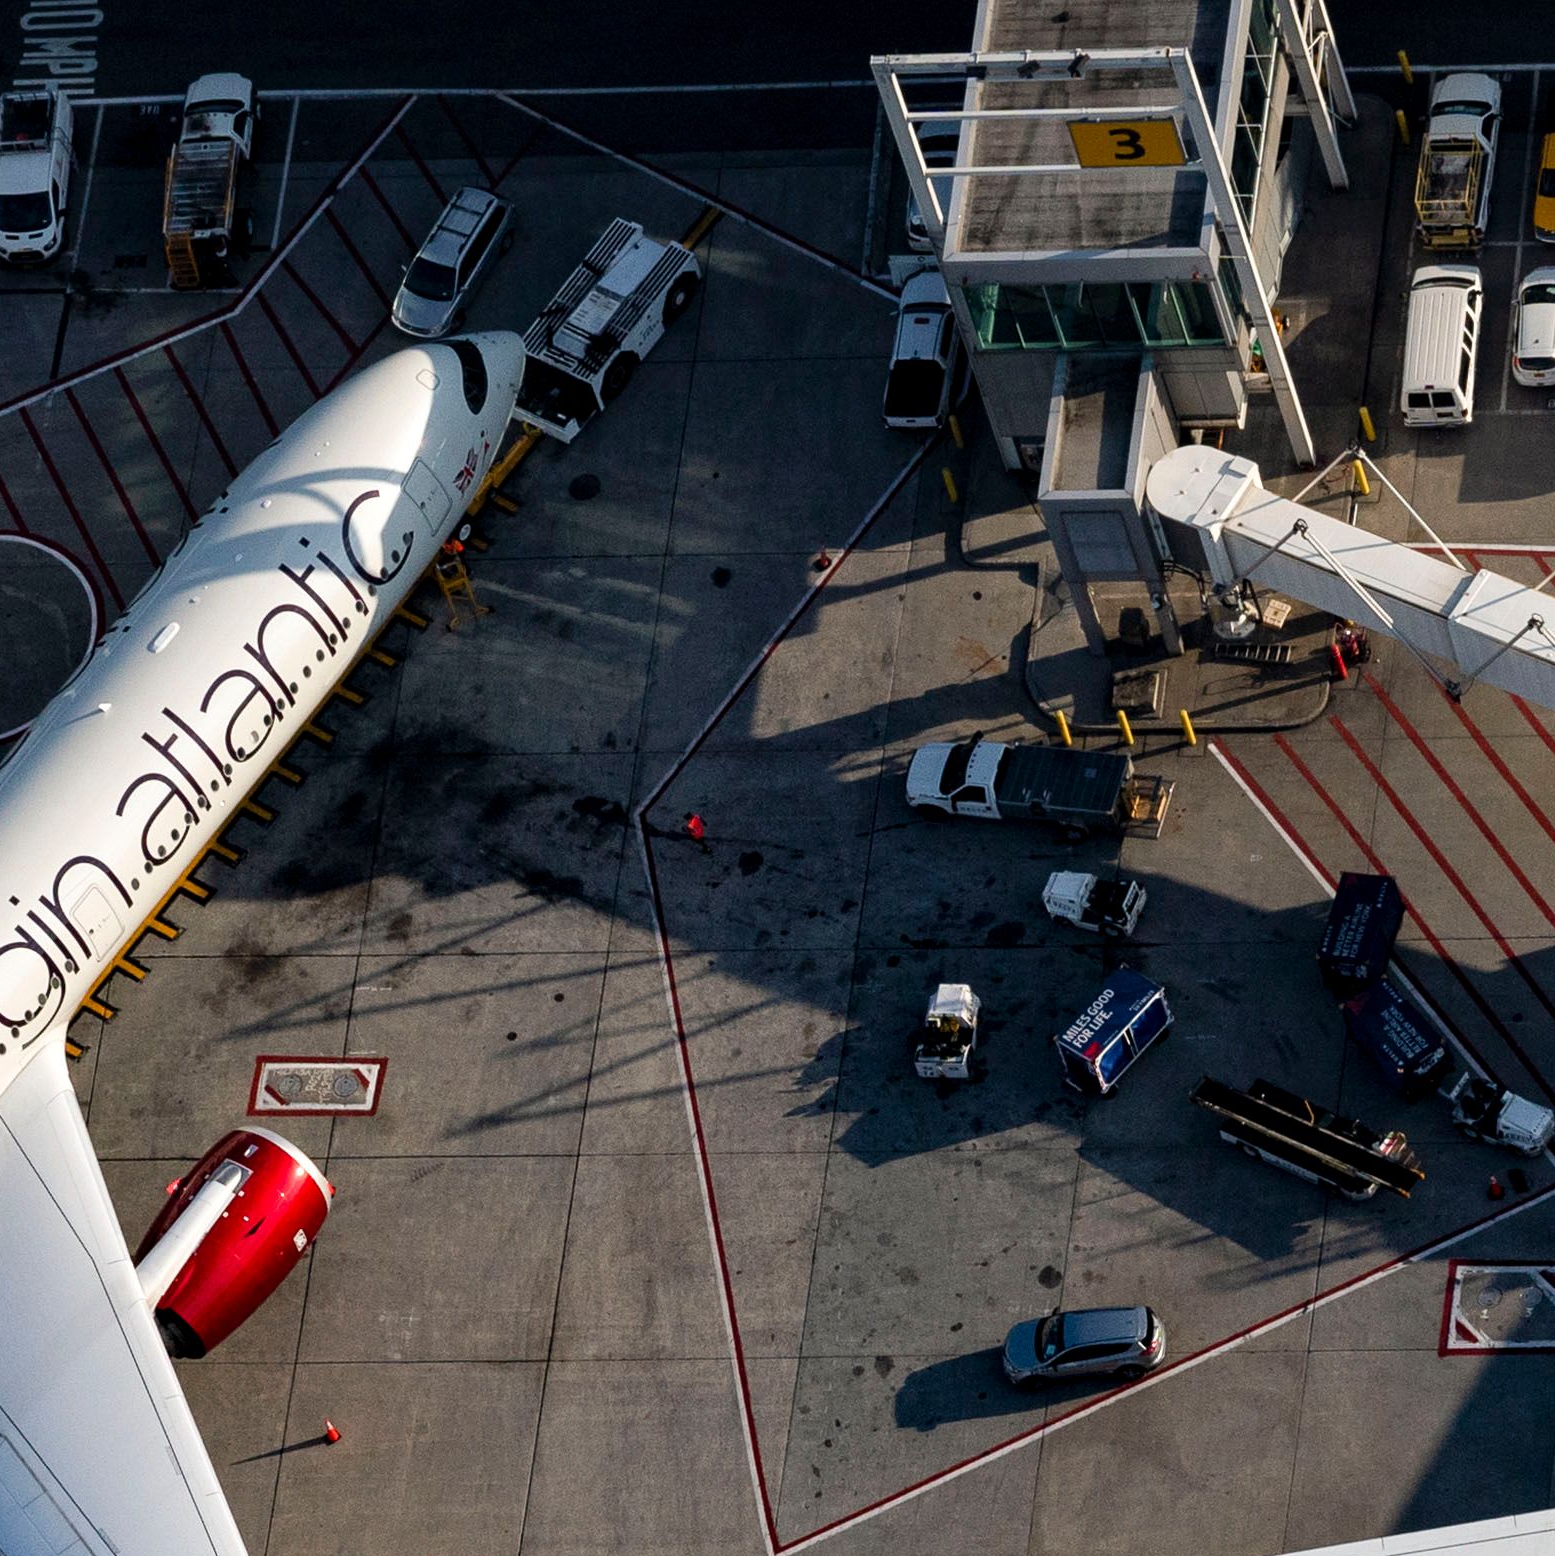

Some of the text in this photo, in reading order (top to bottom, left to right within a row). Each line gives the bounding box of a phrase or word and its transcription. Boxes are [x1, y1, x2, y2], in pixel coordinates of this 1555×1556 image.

[1108, 128, 1146, 159] 3
[116, 489, 414, 866] atlantic
[1332, 922, 1349, 957] BUILDING
[1341, 930, 1355, 957] BETTER
[1349, 944, 1359, 958] FOR
[1354, 925, 1365, 943] NEW
[1062, 1013, 1091, 1043] MILES
[1087, 988, 1115, 1017] GOOD
[1072, 1029, 1095, 1049] FOR
[1089, 1010, 1114, 1031] LIFE.
[1387, 1029, 1415, 1059] BUILDING
[1399, 1031, 1423, 1054] BETTER
[1414, 1034, 1429, 1049] FOR
